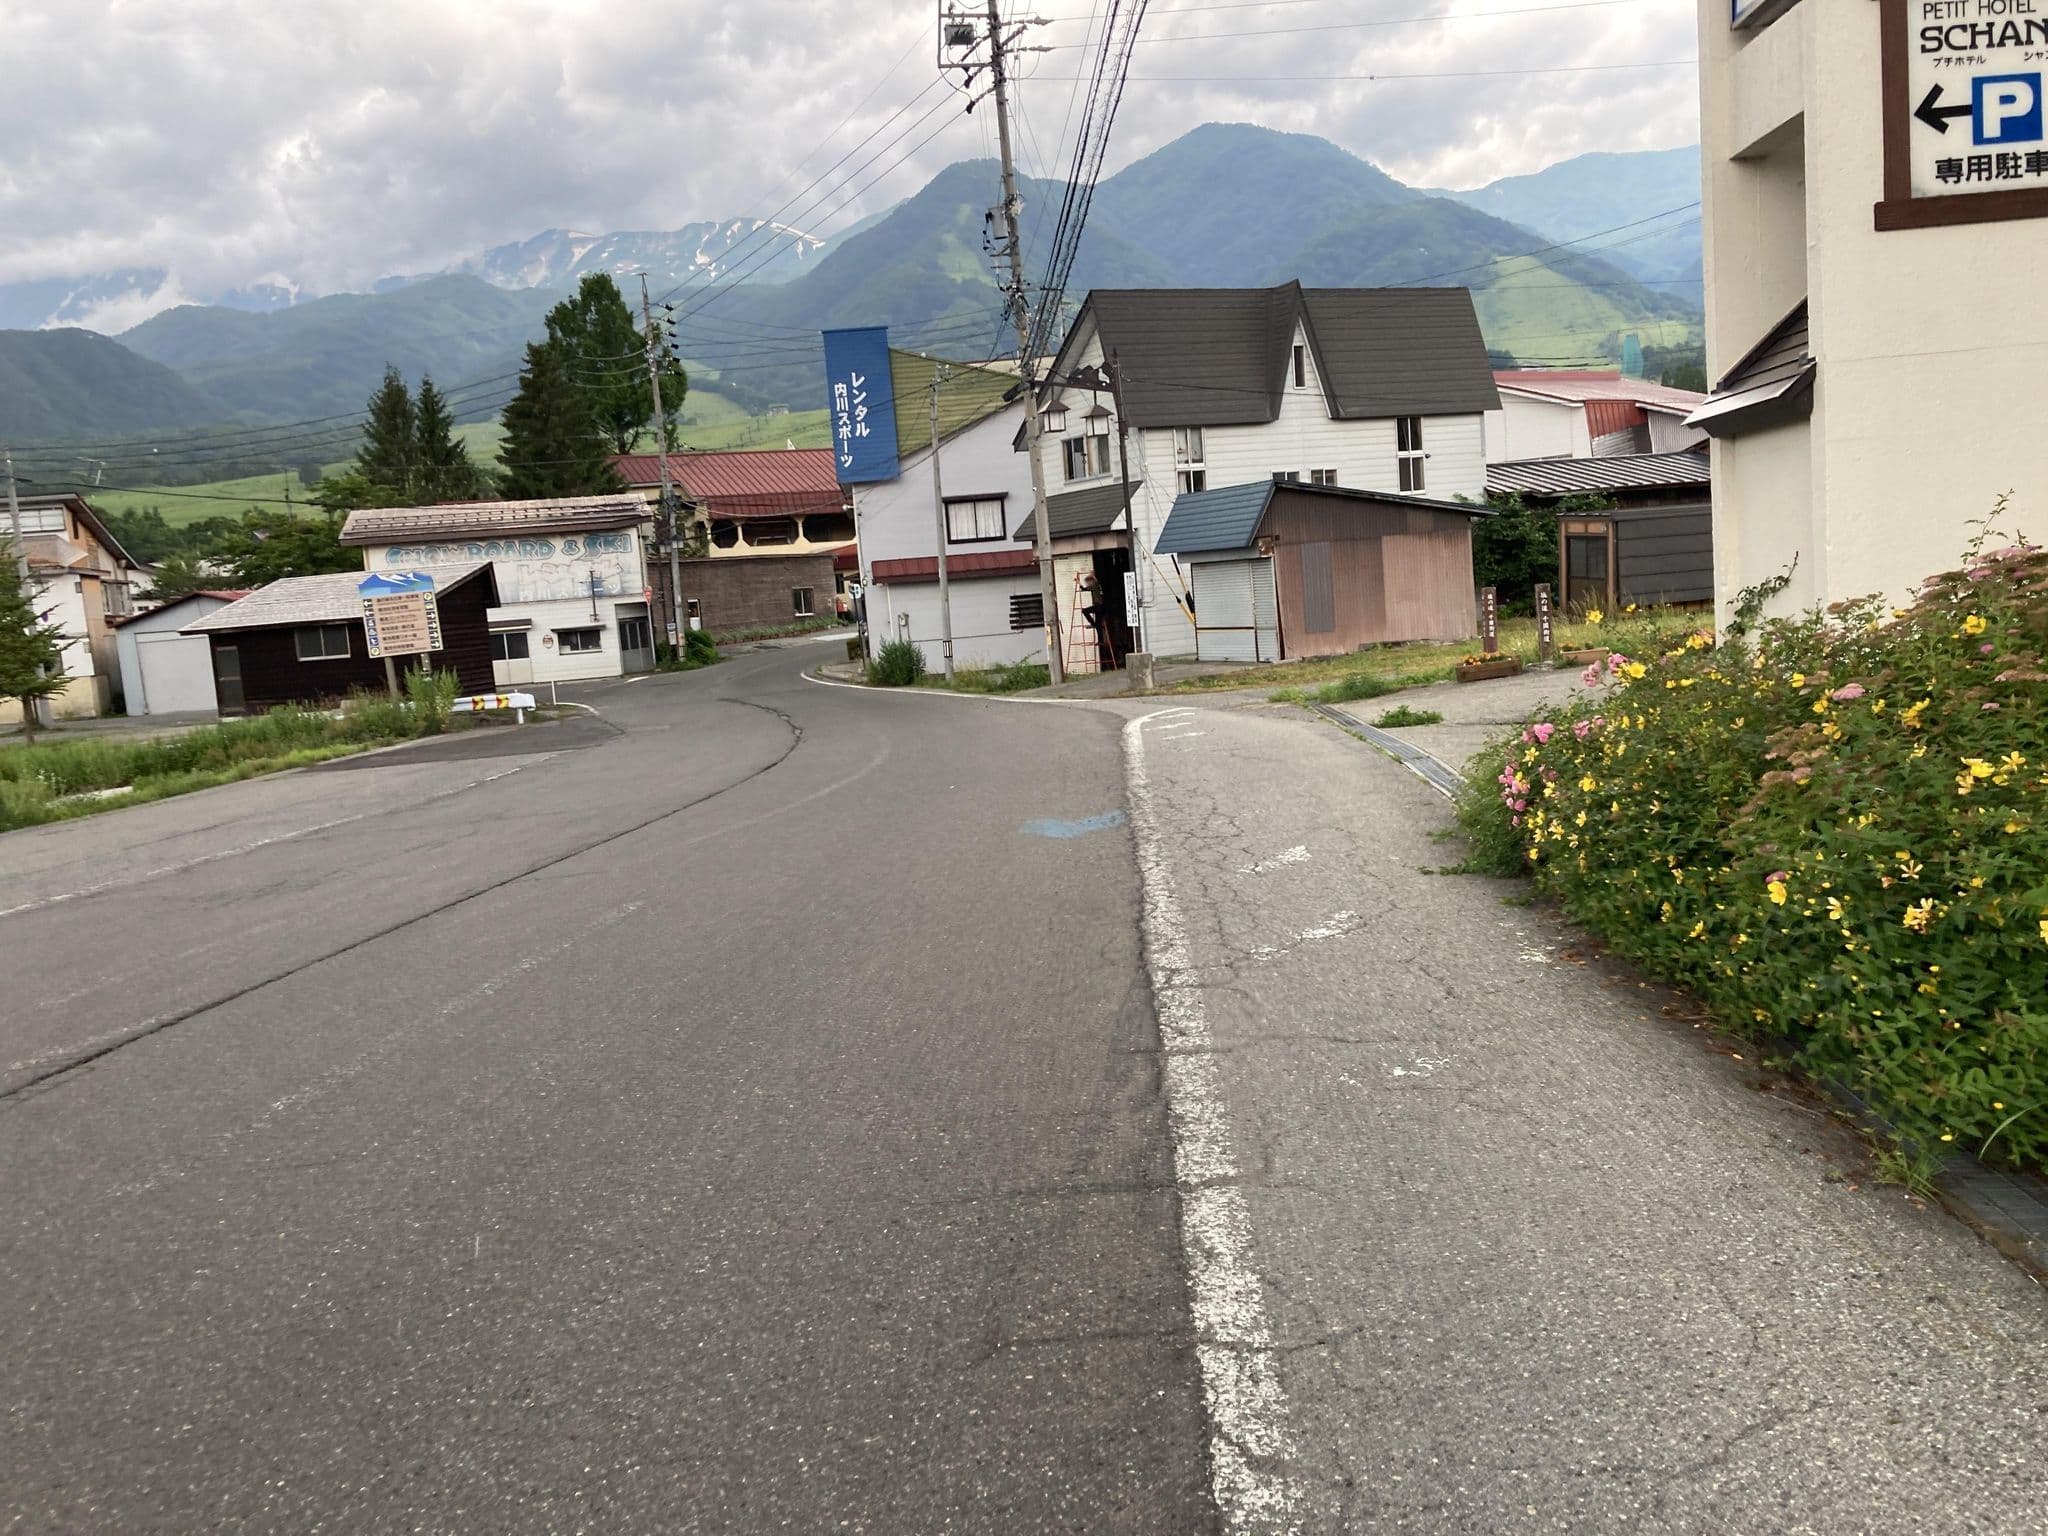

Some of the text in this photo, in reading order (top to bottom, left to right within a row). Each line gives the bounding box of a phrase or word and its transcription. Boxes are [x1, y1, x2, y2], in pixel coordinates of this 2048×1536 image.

[1923, 0, 2037, 20] PETIT HOTEL
[1920, 18, 2048, 54] SCHAN
[1933, 55, 1987, 68] プチホテル
[1982, 81, 2034, 139] P
[1935, 150, 2048, 185] 専用駐車
[851, 372, 870, 438] レンタル
[834, 382, 853, 468] 内川スポーツ
[385, 537, 556, 567] SNOWBOARD
[580, 534, 633, 560] SKI
